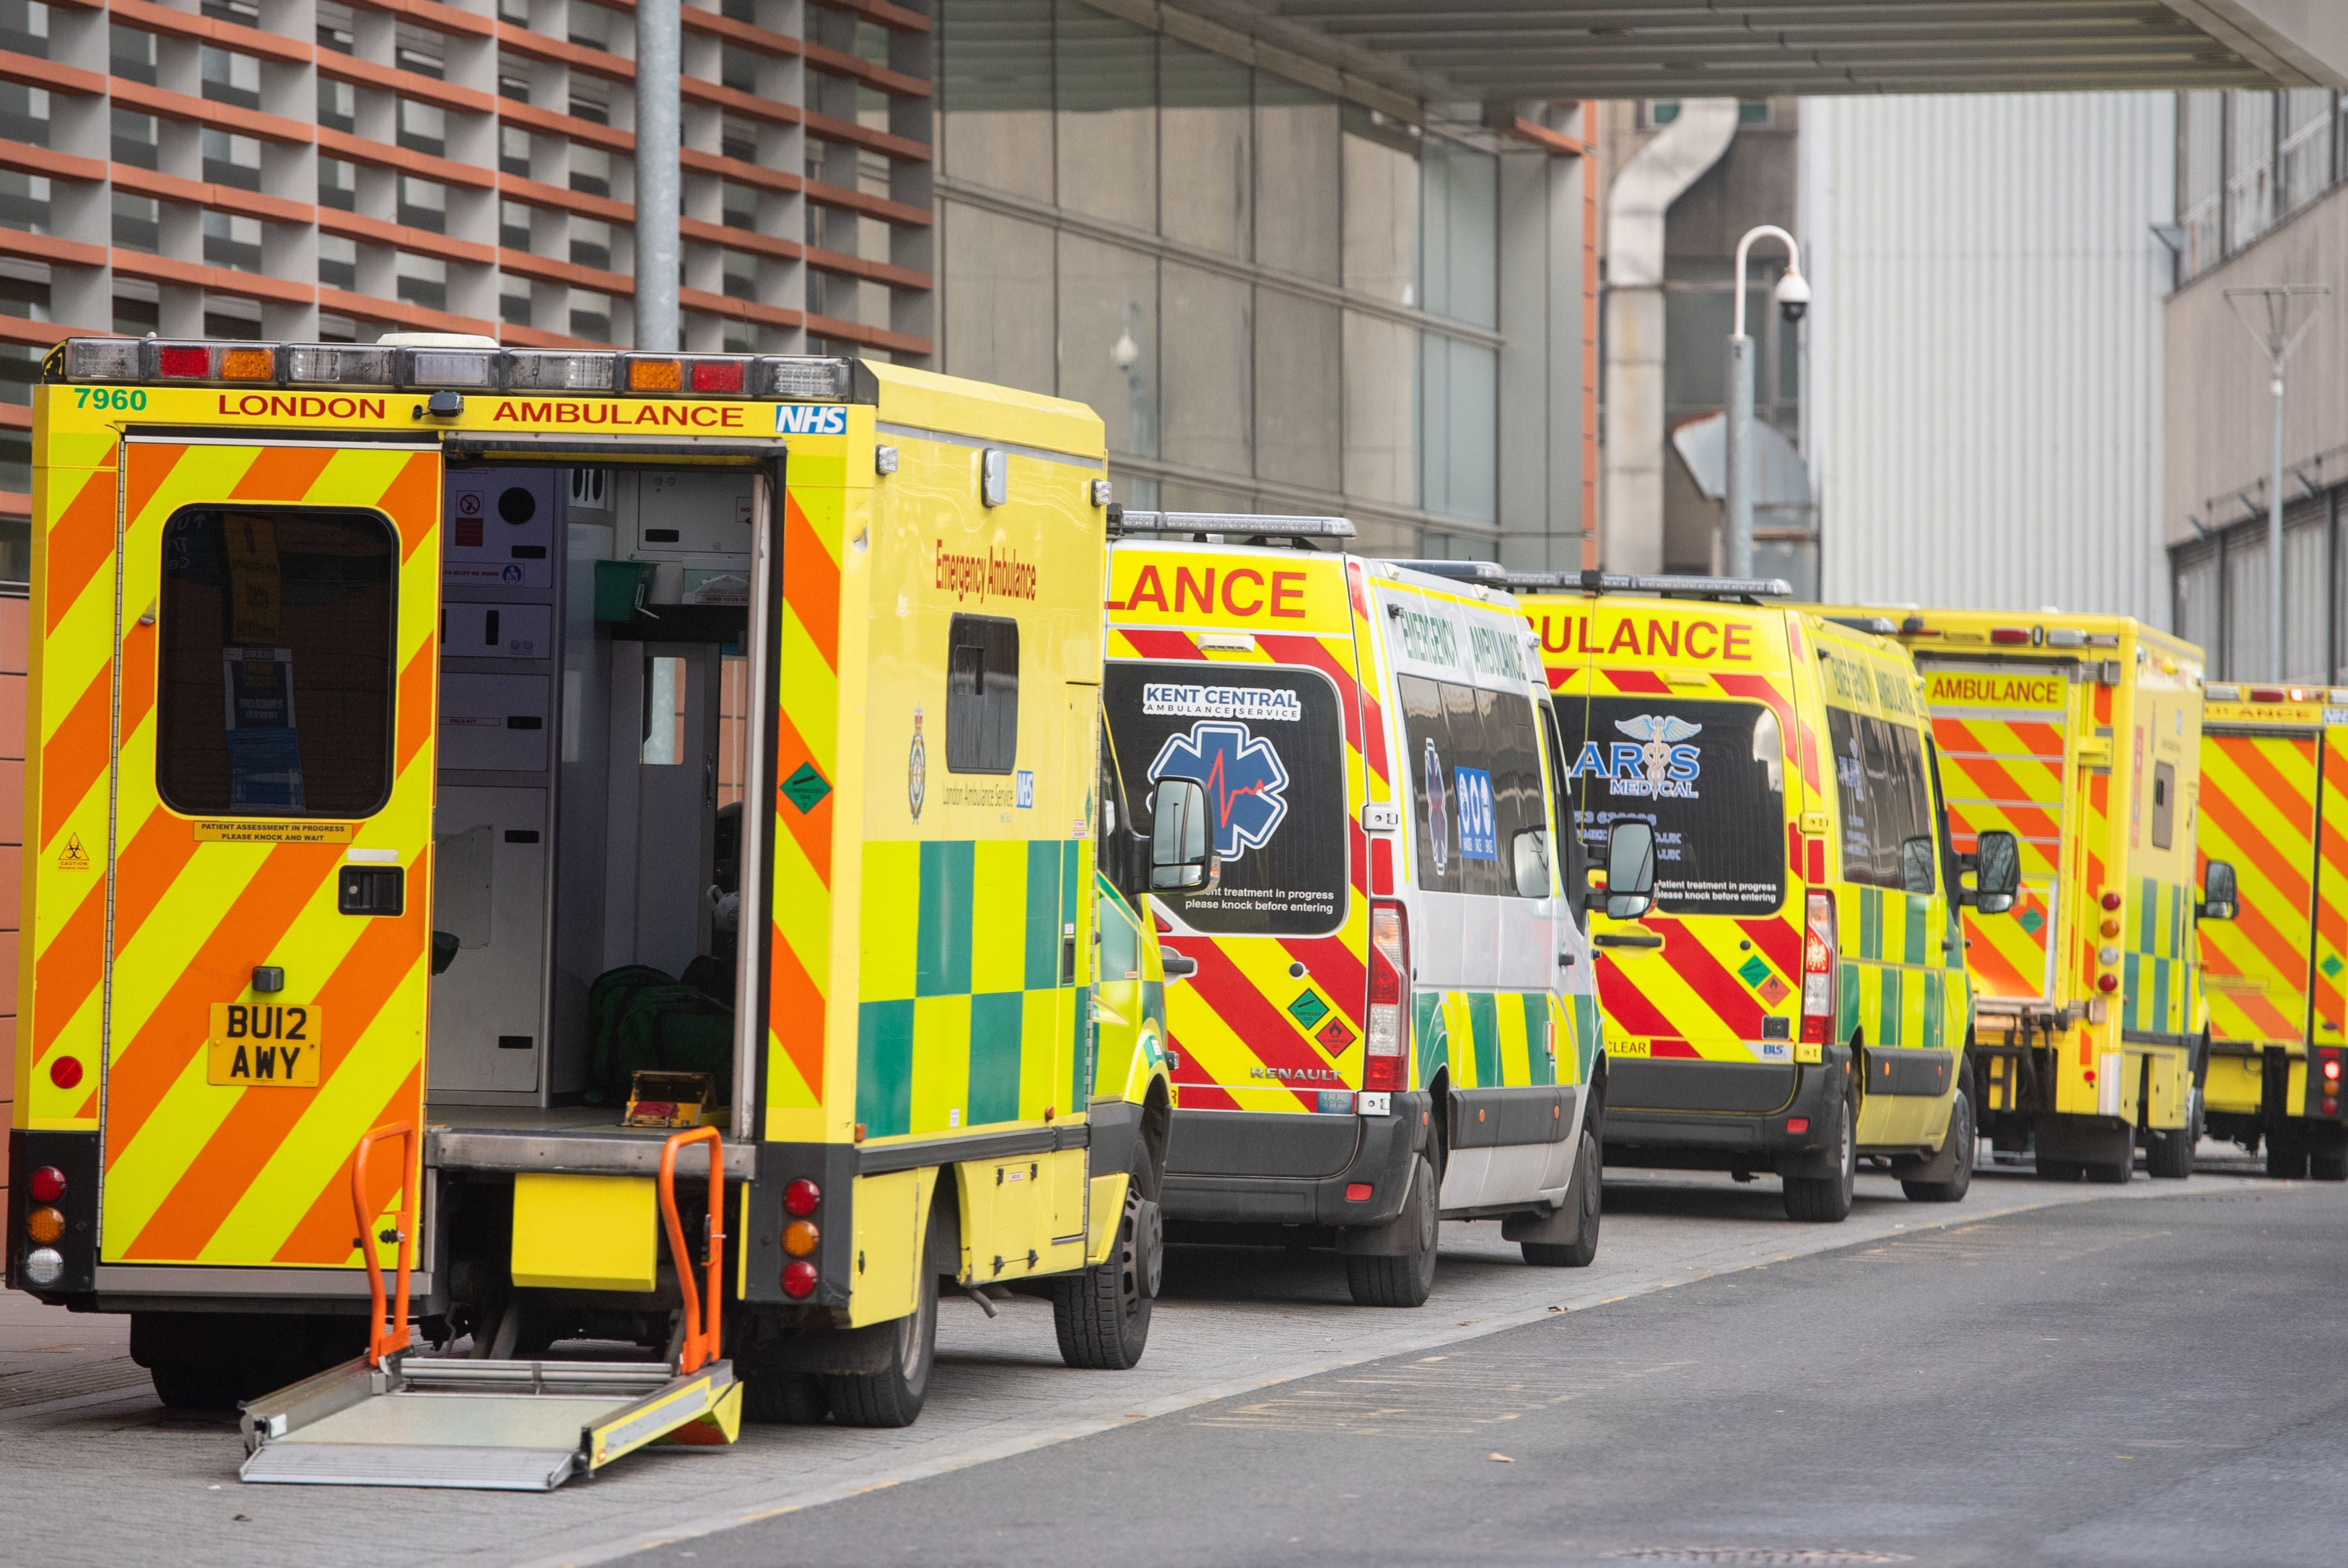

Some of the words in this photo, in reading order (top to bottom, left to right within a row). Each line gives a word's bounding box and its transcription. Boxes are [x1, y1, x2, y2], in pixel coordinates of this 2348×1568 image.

[73, 387, 147, 411] 7960
[218, 394, 385, 419] LONDON
[492, 401, 744, 427] AMBULANCE
[776, 406, 846, 434] NHS
[936, 539, 987, 604] Emergency
[987, 546, 1036, 601] Ambulance
[1400, 610, 1461, 668] EMERGENCY
[1469, 625, 1528, 681] AMBULANCE
[1524, 616, 1753, 661] ULANCE
[1146, 687, 1200, 703] KENT
[1205, 690, 1298, 708] CENTRAL
[1932, 677, 2059, 704] AMBULANCE
[1146, 704, 1230, 714] AMBULANCE
[1239, 708, 1298, 718] SERVICE
[943, 780, 964, 805] London
[964, 781, 994, 806] Ambulance
[995, 782, 1013, 807] Service
[1016, 771, 1033, 807] NHS
[1224, 888, 1273, 898] treatment
[1275, 888, 1285, 898] in
[1288, 890, 1335, 901] progress
[1685, 890, 1711, 901] knock
[1712, 891, 1740, 901] before
[1741, 893, 1776, 903] entering
[1686, 880, 1727, 890] treatment
[1729, 881, 1737, 890] in
[1739, 882, 1777, 893] progress
[1185, 899, 1219, 911] please
[1221, 900, 1253, 910] knock
[1255, 900, 1288, 911] before
[1290, 903, 1334, 915] entering
[226, 1005, 307, 1041] BU12
[230, 1045, 301, 1079] AWY
[1763, 1044, 1784, 1054] BLS
[1250, 1067, 1343, 1082] RENAULT
